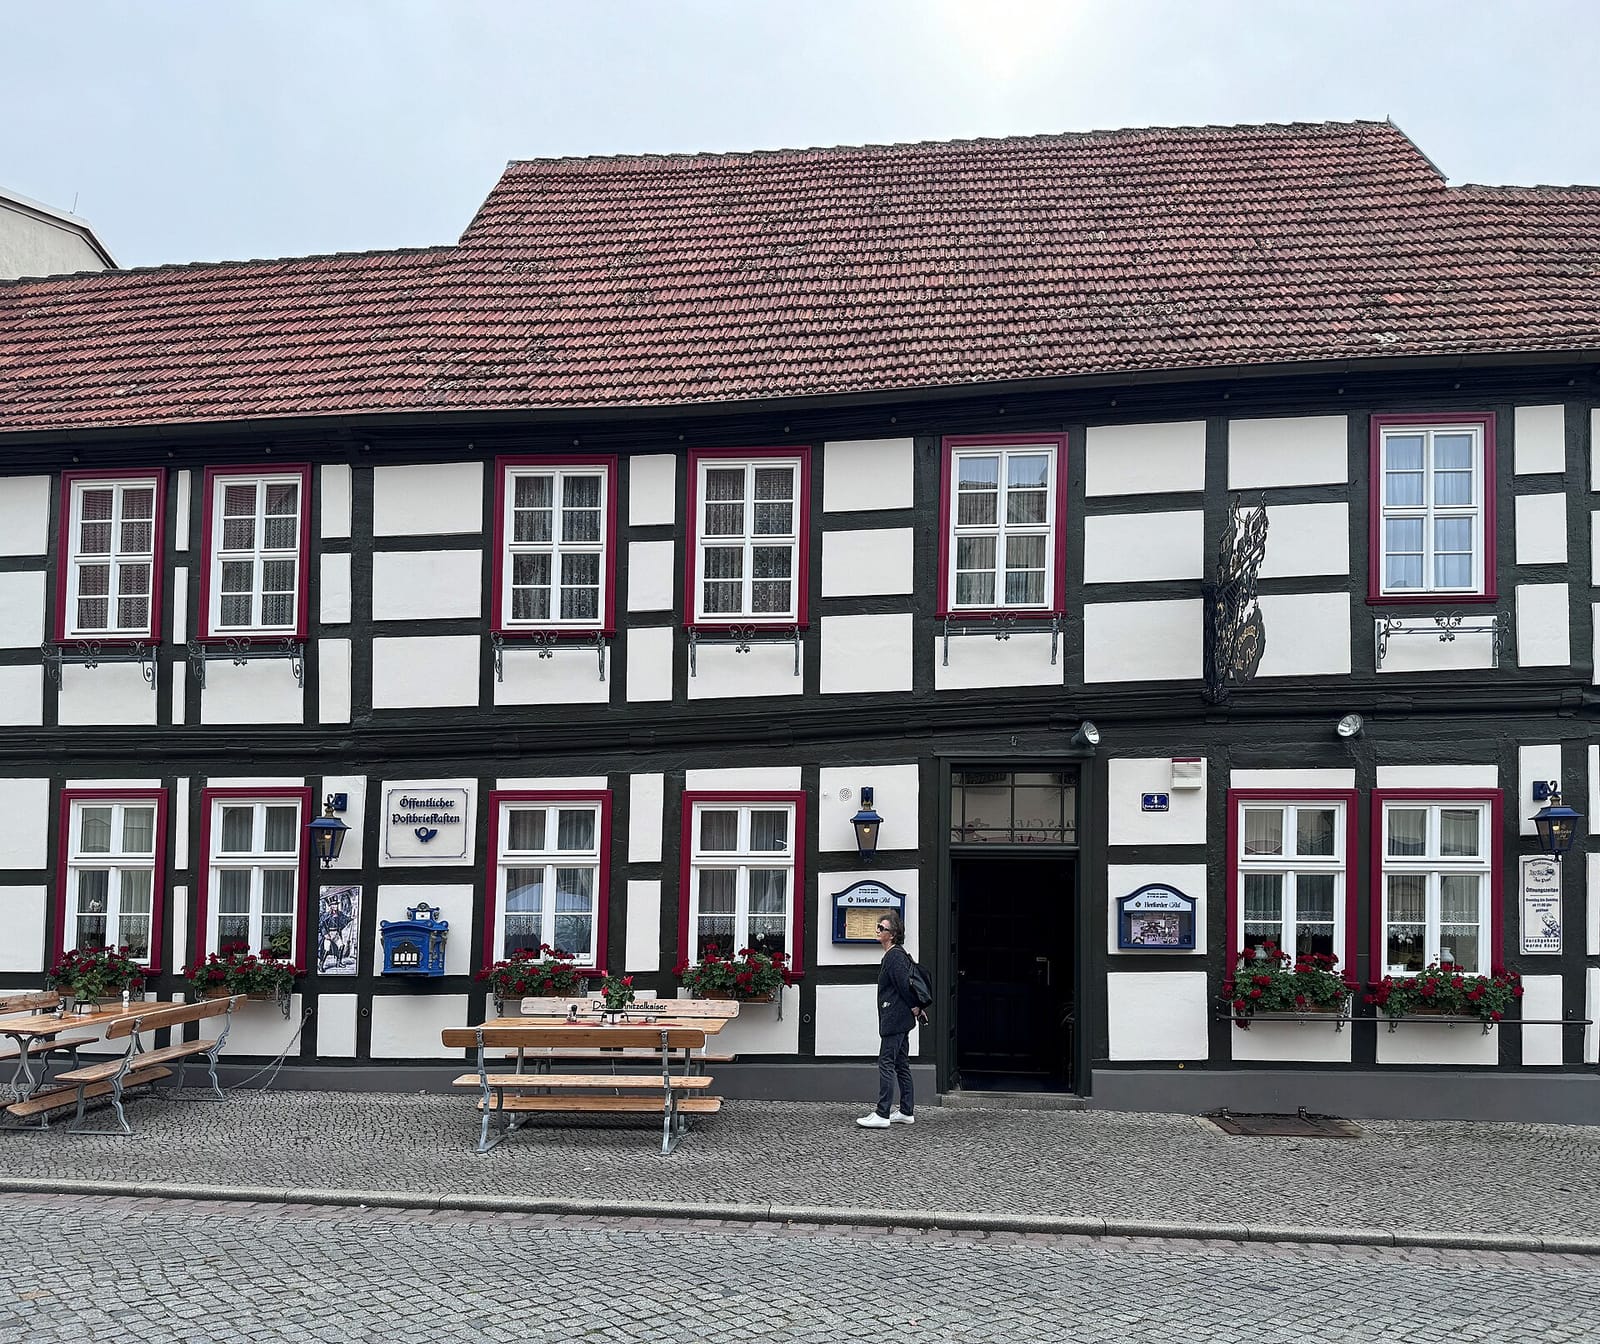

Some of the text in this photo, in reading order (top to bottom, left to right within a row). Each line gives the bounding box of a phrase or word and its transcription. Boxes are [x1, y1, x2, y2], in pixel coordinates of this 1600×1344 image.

[399, 795, 455, 809] Öffentlicher
[1151, 795, 1158, 804] 4
[593, 1000, 668, 1011] De nitzelkaiser
